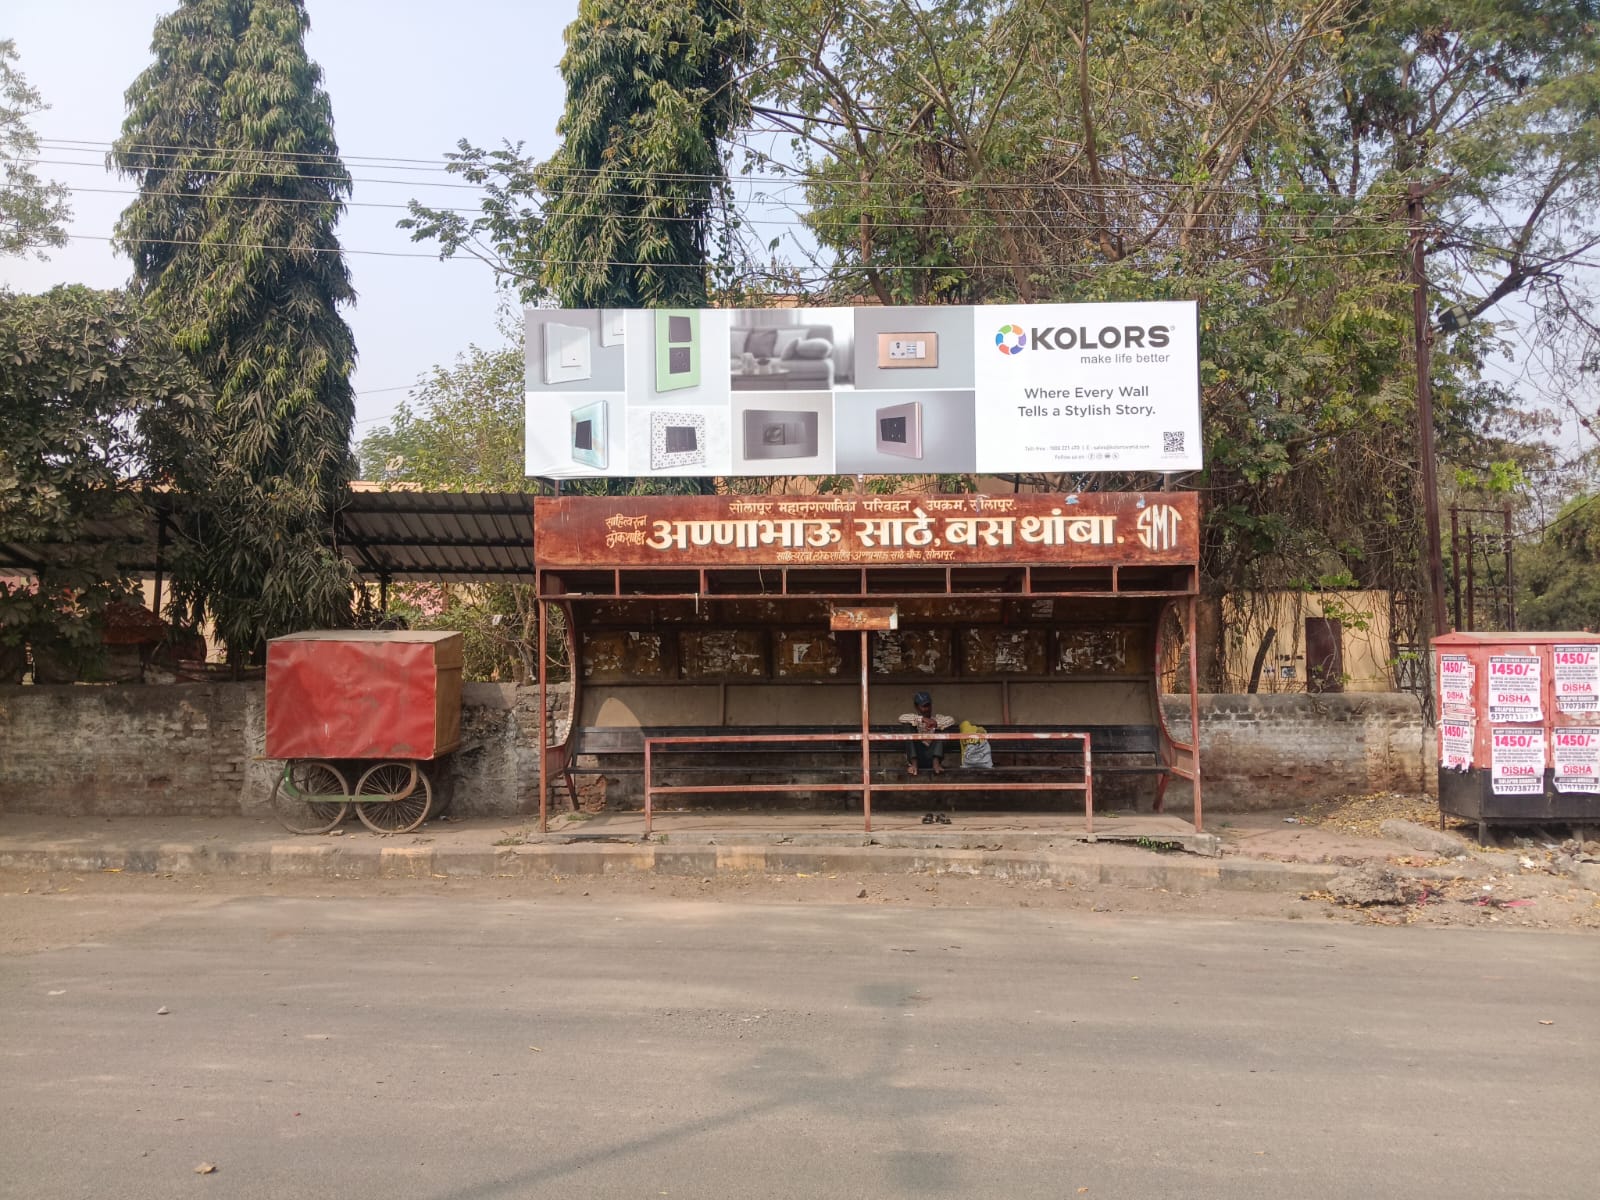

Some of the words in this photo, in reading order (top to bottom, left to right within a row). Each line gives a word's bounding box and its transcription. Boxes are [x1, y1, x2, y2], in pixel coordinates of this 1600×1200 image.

[1031, 325, 1170, 351] KOLORS
[1080, 354, 1112, 364] make
[1115, 353, 1133, 364] life
[1136, 353, 1171, 363] better
[1024, 387, 1071, 399] Where
[1075, 386, 1114, 400] Every
[1118, 385, 1149, 397] Wall
[1017, 405, 1048, 417] Tells
[1052, 408, 1060, 417] a
[1065, 404, 1111, 418] Stylish
[1115, 403, 1156, 417] Story.
[729, 500, 774, 515] सोलापूर
[778, 499, 857, 516] महानगरपालिका
[862, 498, 911, 512] परिवहन
[646, 519, 842, 550] अण्णाभाऊ
[945, 517, 1017, 547] बस
[1137, 504, 1182, 550] SMT
[1555, 653, 1595, 665] 1450/-
[1491, 664, 1535, 676] 1450/-
[1494, 736, 1539, 747] 1450/-
[1556, 735, 1596, 746] 1450/-
